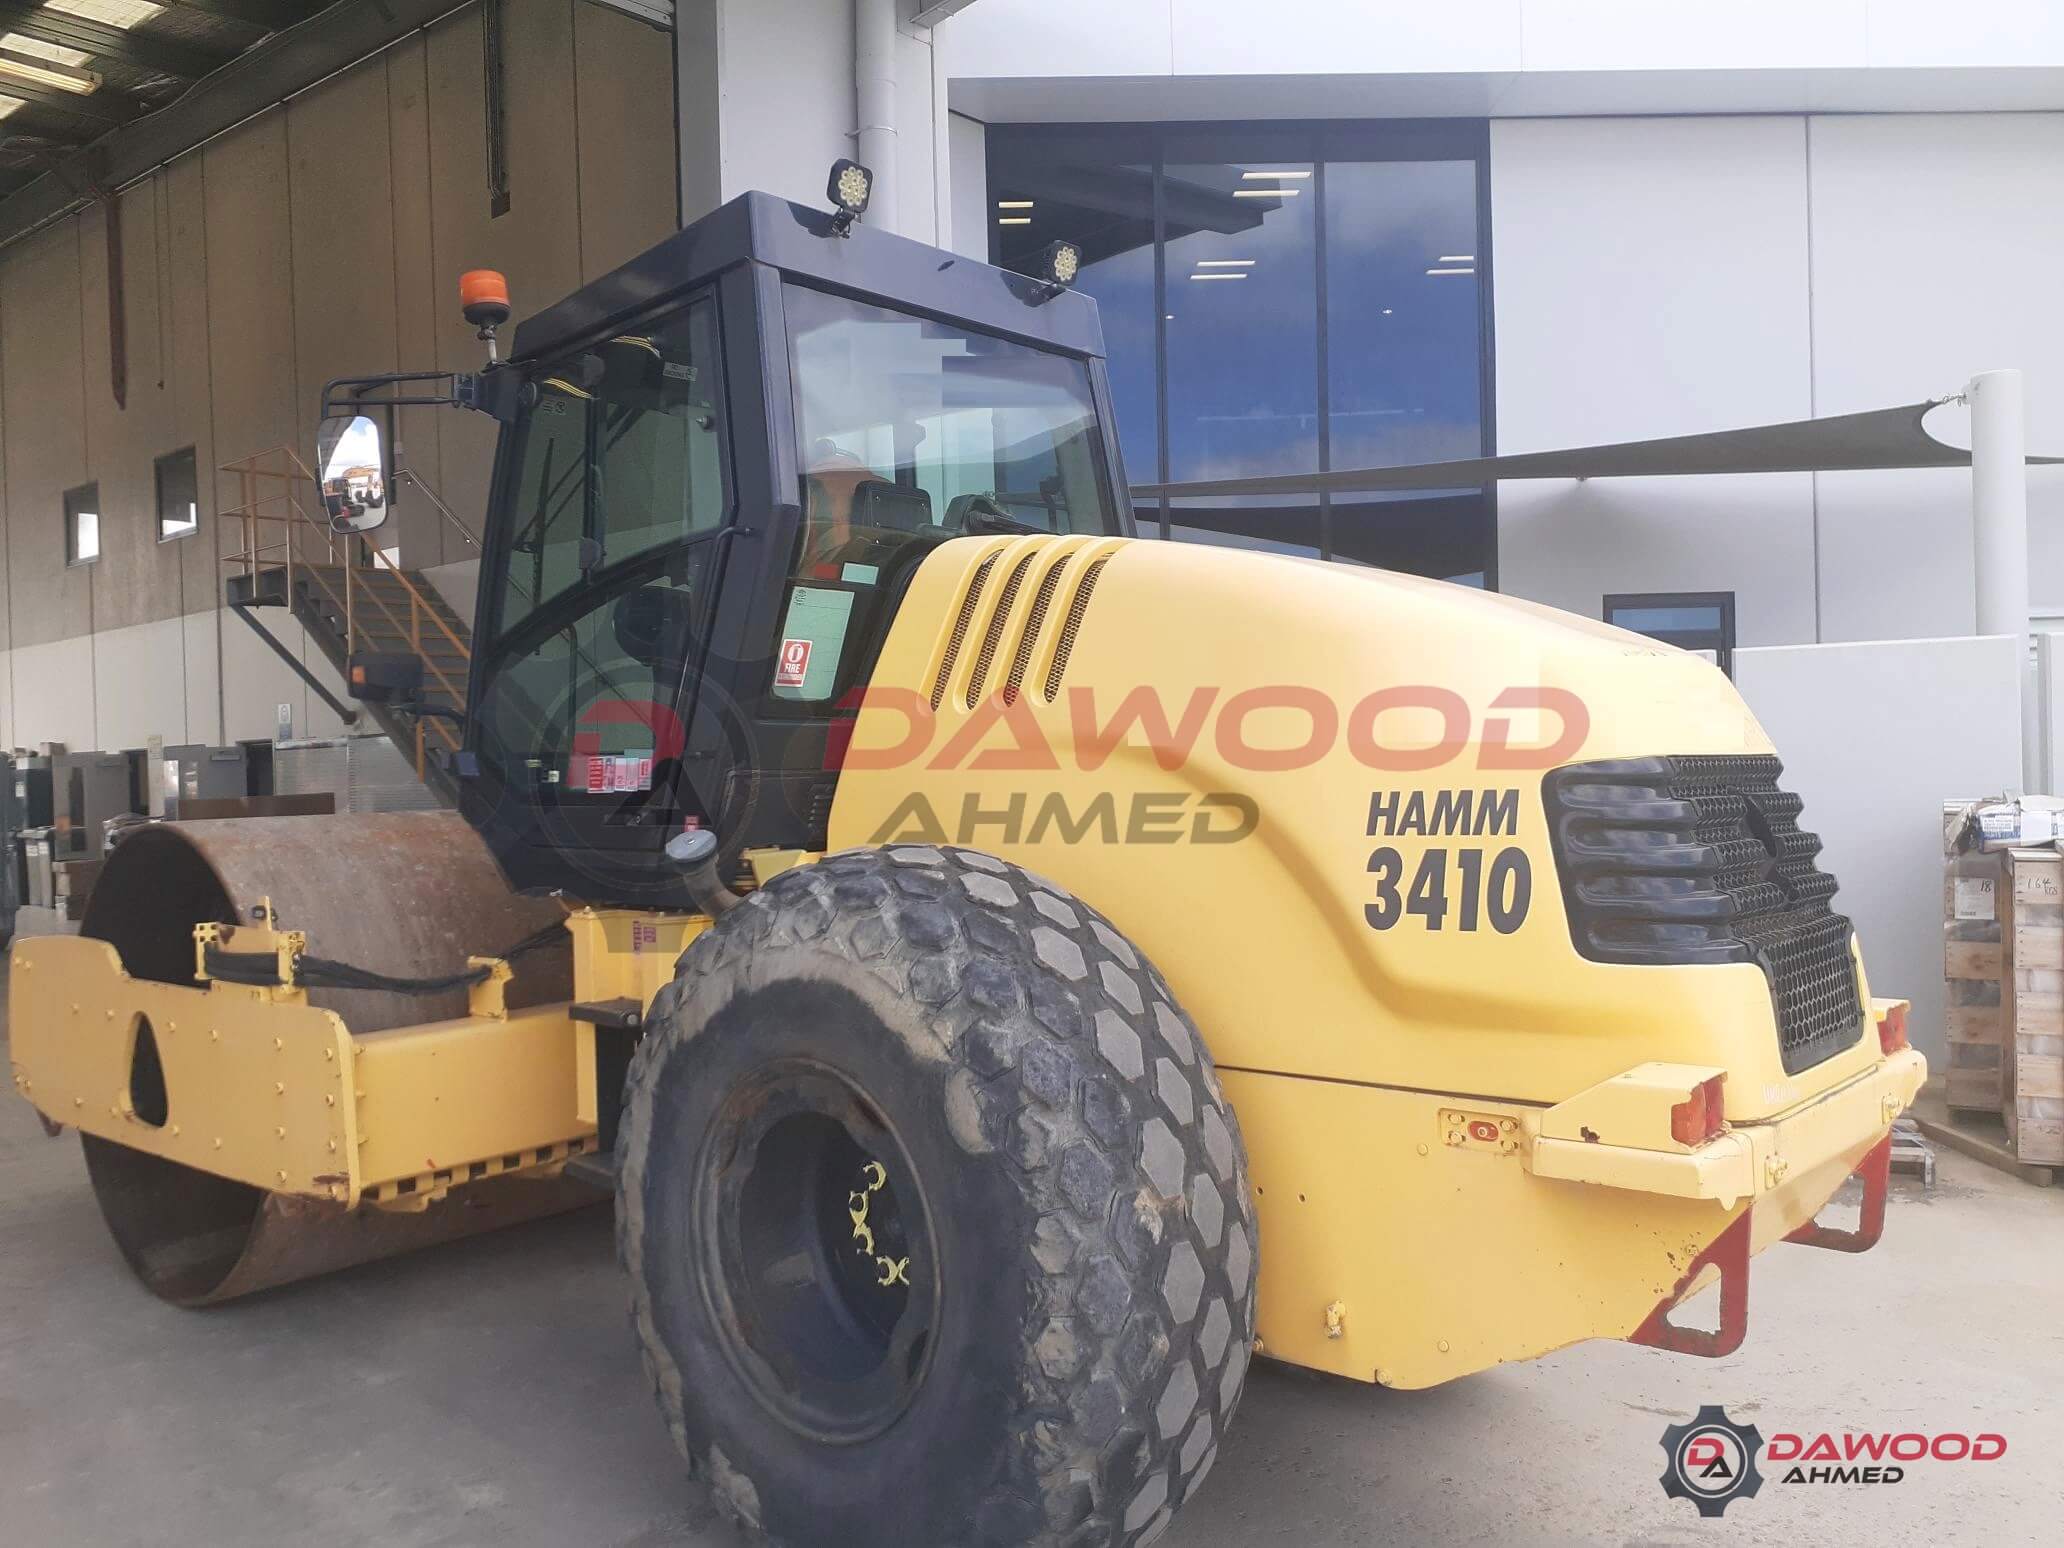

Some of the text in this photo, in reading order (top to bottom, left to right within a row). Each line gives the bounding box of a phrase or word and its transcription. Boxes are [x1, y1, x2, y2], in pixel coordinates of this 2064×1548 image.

[784, 663, 801, 674] FIRE
[1366, 789, 1519, 836] HAMM
[1364, 846, 1532, 934] 3410
